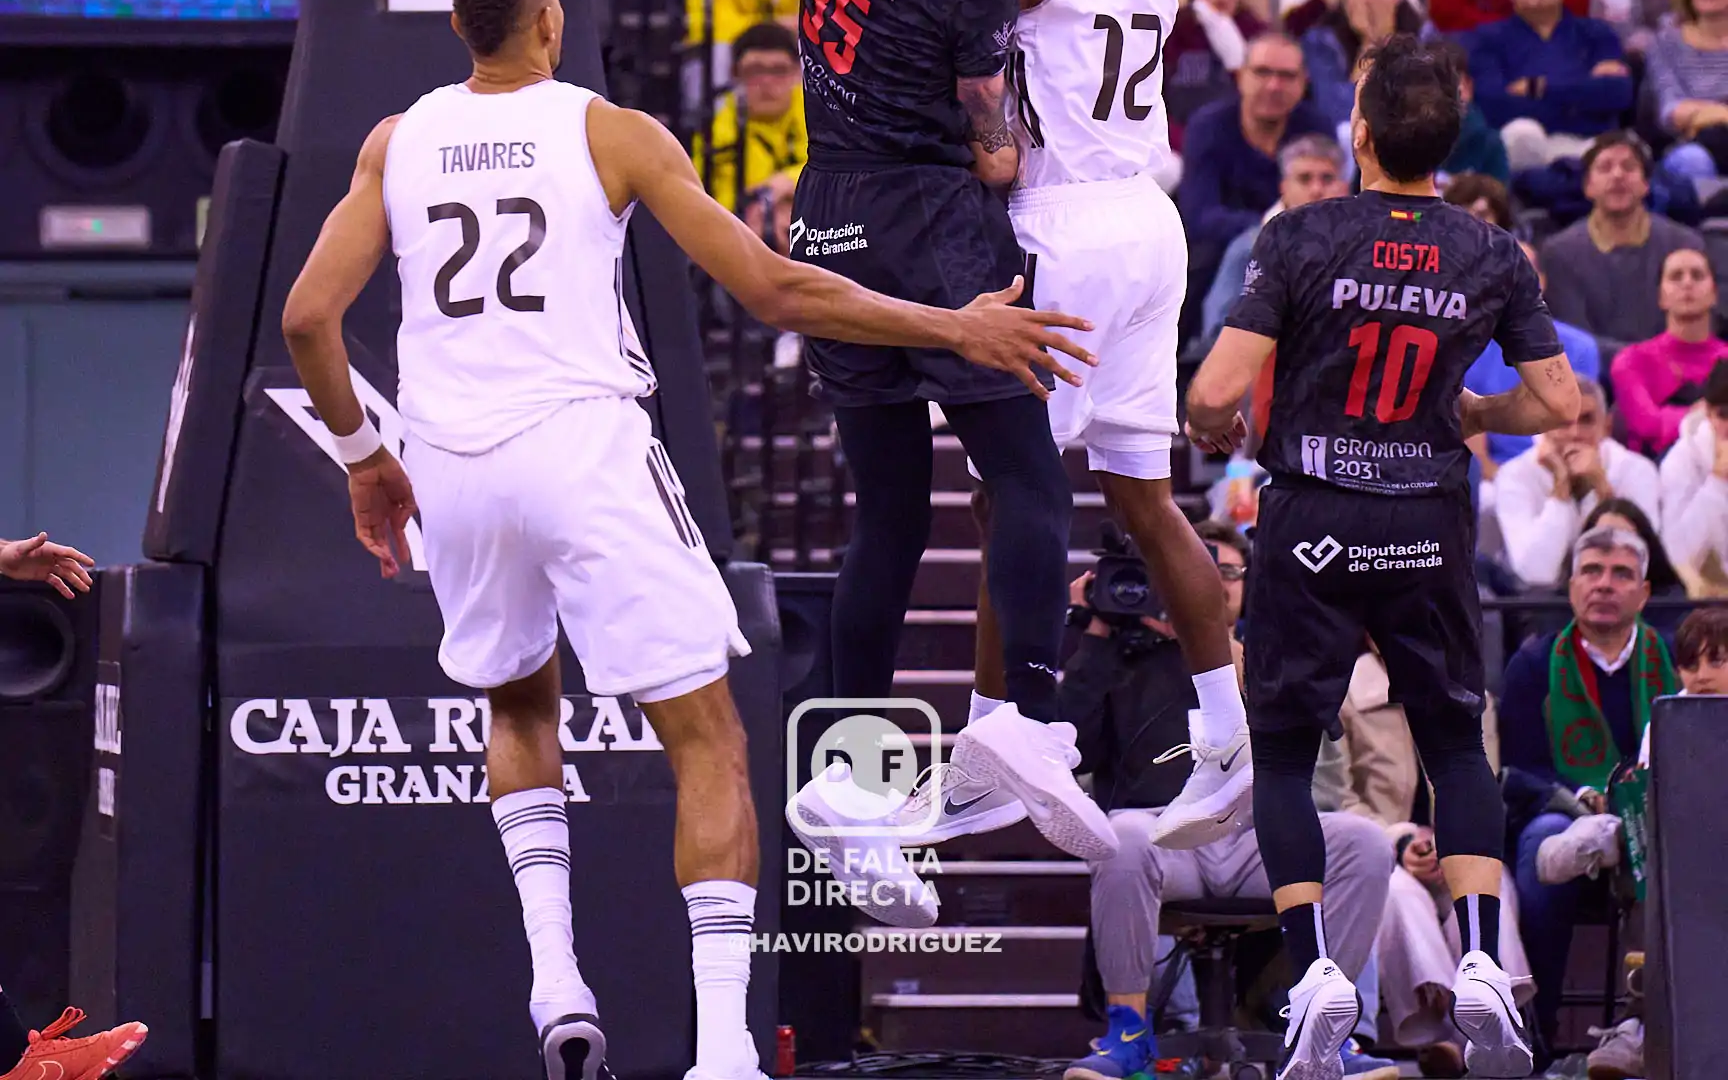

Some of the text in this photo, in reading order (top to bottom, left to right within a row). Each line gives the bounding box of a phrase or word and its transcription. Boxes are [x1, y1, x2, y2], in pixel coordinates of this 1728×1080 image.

[1092, 13, 1162, 121] 12
[438, 142, 536, 174] TAVARES
[427, 197, 547, 318] 22
[821, 237, 868, 255] Granada
[1373, 240, 1440, 273] COSTA
[1332, 278, 1467, 320] PULEVA
[1344, 321, 1439, 424] 10
[1333, 459, 1381, 480] 2031
[1348, 539, 1440, 560] Diputación
[1373, 554, 1443, 571] Granada
[1348, 561, 1370, 573] de
[229, 698, 412, 758] CAJA
